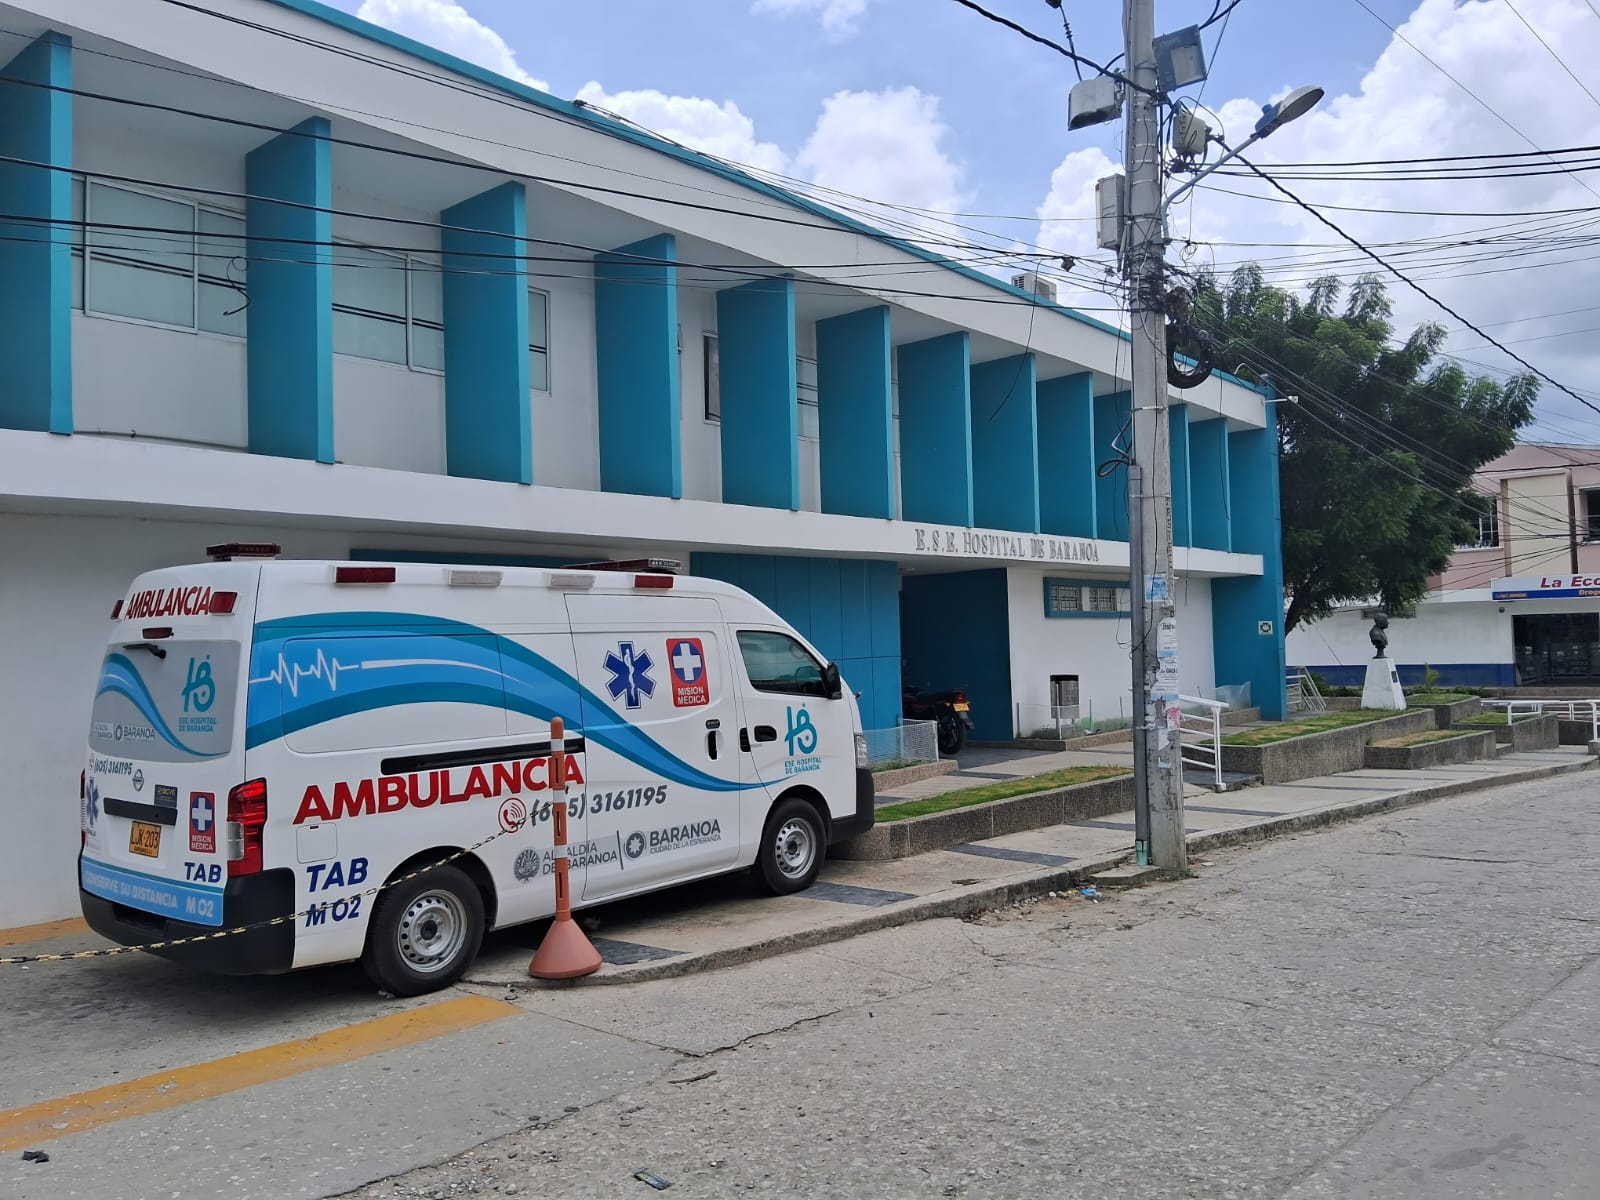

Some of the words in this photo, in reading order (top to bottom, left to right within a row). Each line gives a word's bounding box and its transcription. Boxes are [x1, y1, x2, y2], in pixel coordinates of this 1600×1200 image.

[963, 532, 1025, 557] HOSPITAL
[1030, 538, 1044, 558] DE
[1049, 540, 1099, 562] BARANOA
[1541, 577, 1562, 588] La
[124, 586, 212, 620] AMBULANCIA
[677, 686, 704, 696] MISION
[677, 695, 706, 705] MEDICA
[124, 726, 156, 739] BARANOA
[785, 760, 795, 768] ESE
[796, 757, 821, 766] HOSPITAL
[785, 767, 793, 775] DE
[794, 764, 821, 773] BARANOA
[531, 793, 587, 827] (65)
[590, 785, 668, 814] 3161195
[650, 819, 721, 847] BARANOA
[543, 840, 598, 862] ALALDÍA
[184, 862, 222, 883] TAB
[306, 857, 369, 893] TAB
[543, 862, 556, 875] DE
[120, 882, 131, 898] SU
[132, 885, 178, 909] DISTANCIA
